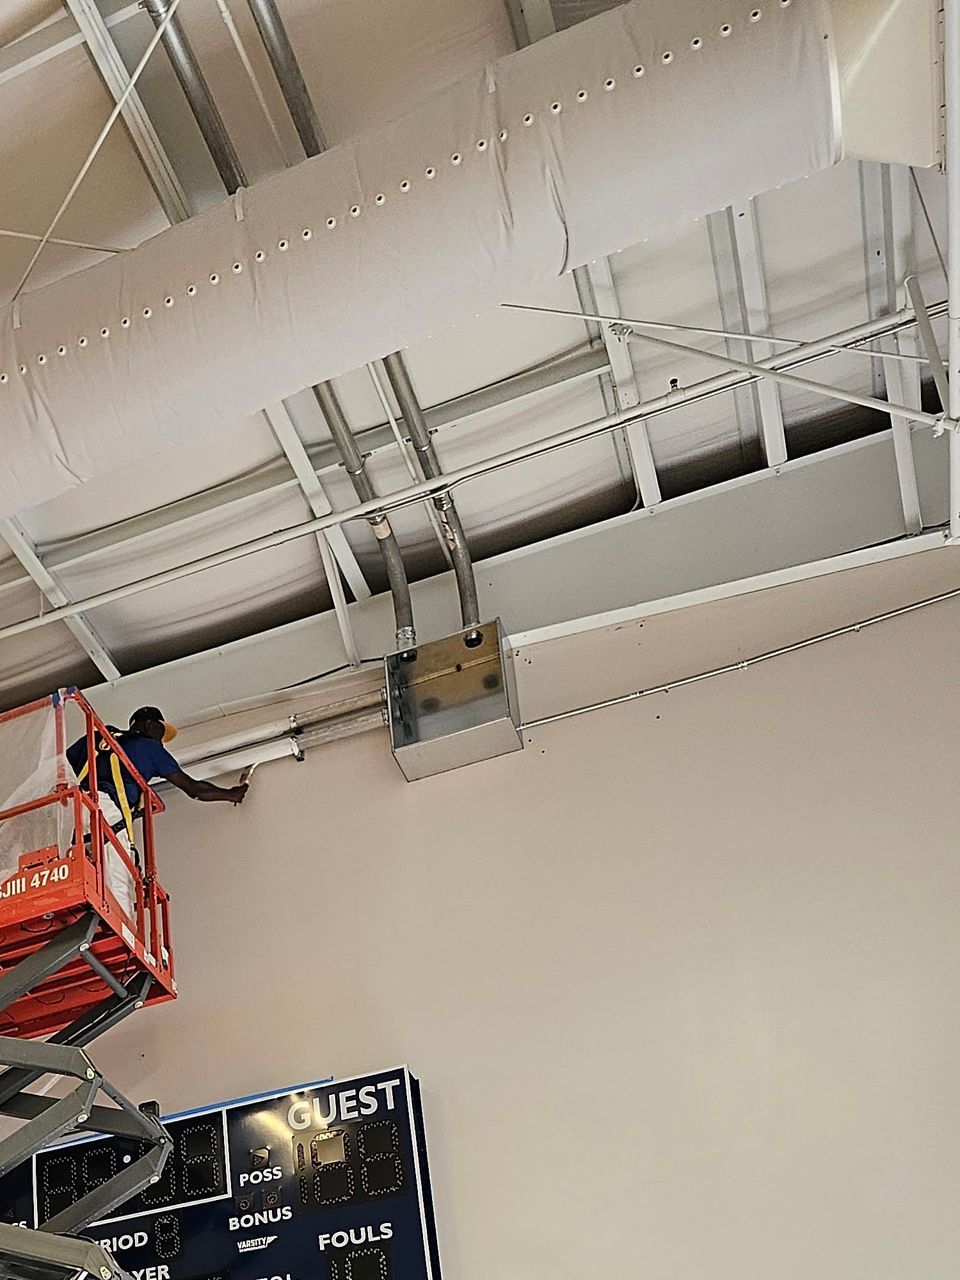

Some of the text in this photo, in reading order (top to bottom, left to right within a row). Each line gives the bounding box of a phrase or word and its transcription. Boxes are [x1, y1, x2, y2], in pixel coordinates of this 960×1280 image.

[30, 864, 69, 888] 4740
[287, 1078, 401, 1130] GUEST
[239, 1166, 283, 1187] POSS
[228, 1206, 293, 1231] BONUS
[96, 1231, 149, 1253] RIOD
[237, 1236, 267, 1249] VARSITY
[318, 1222, 394, 1251] FOULS
